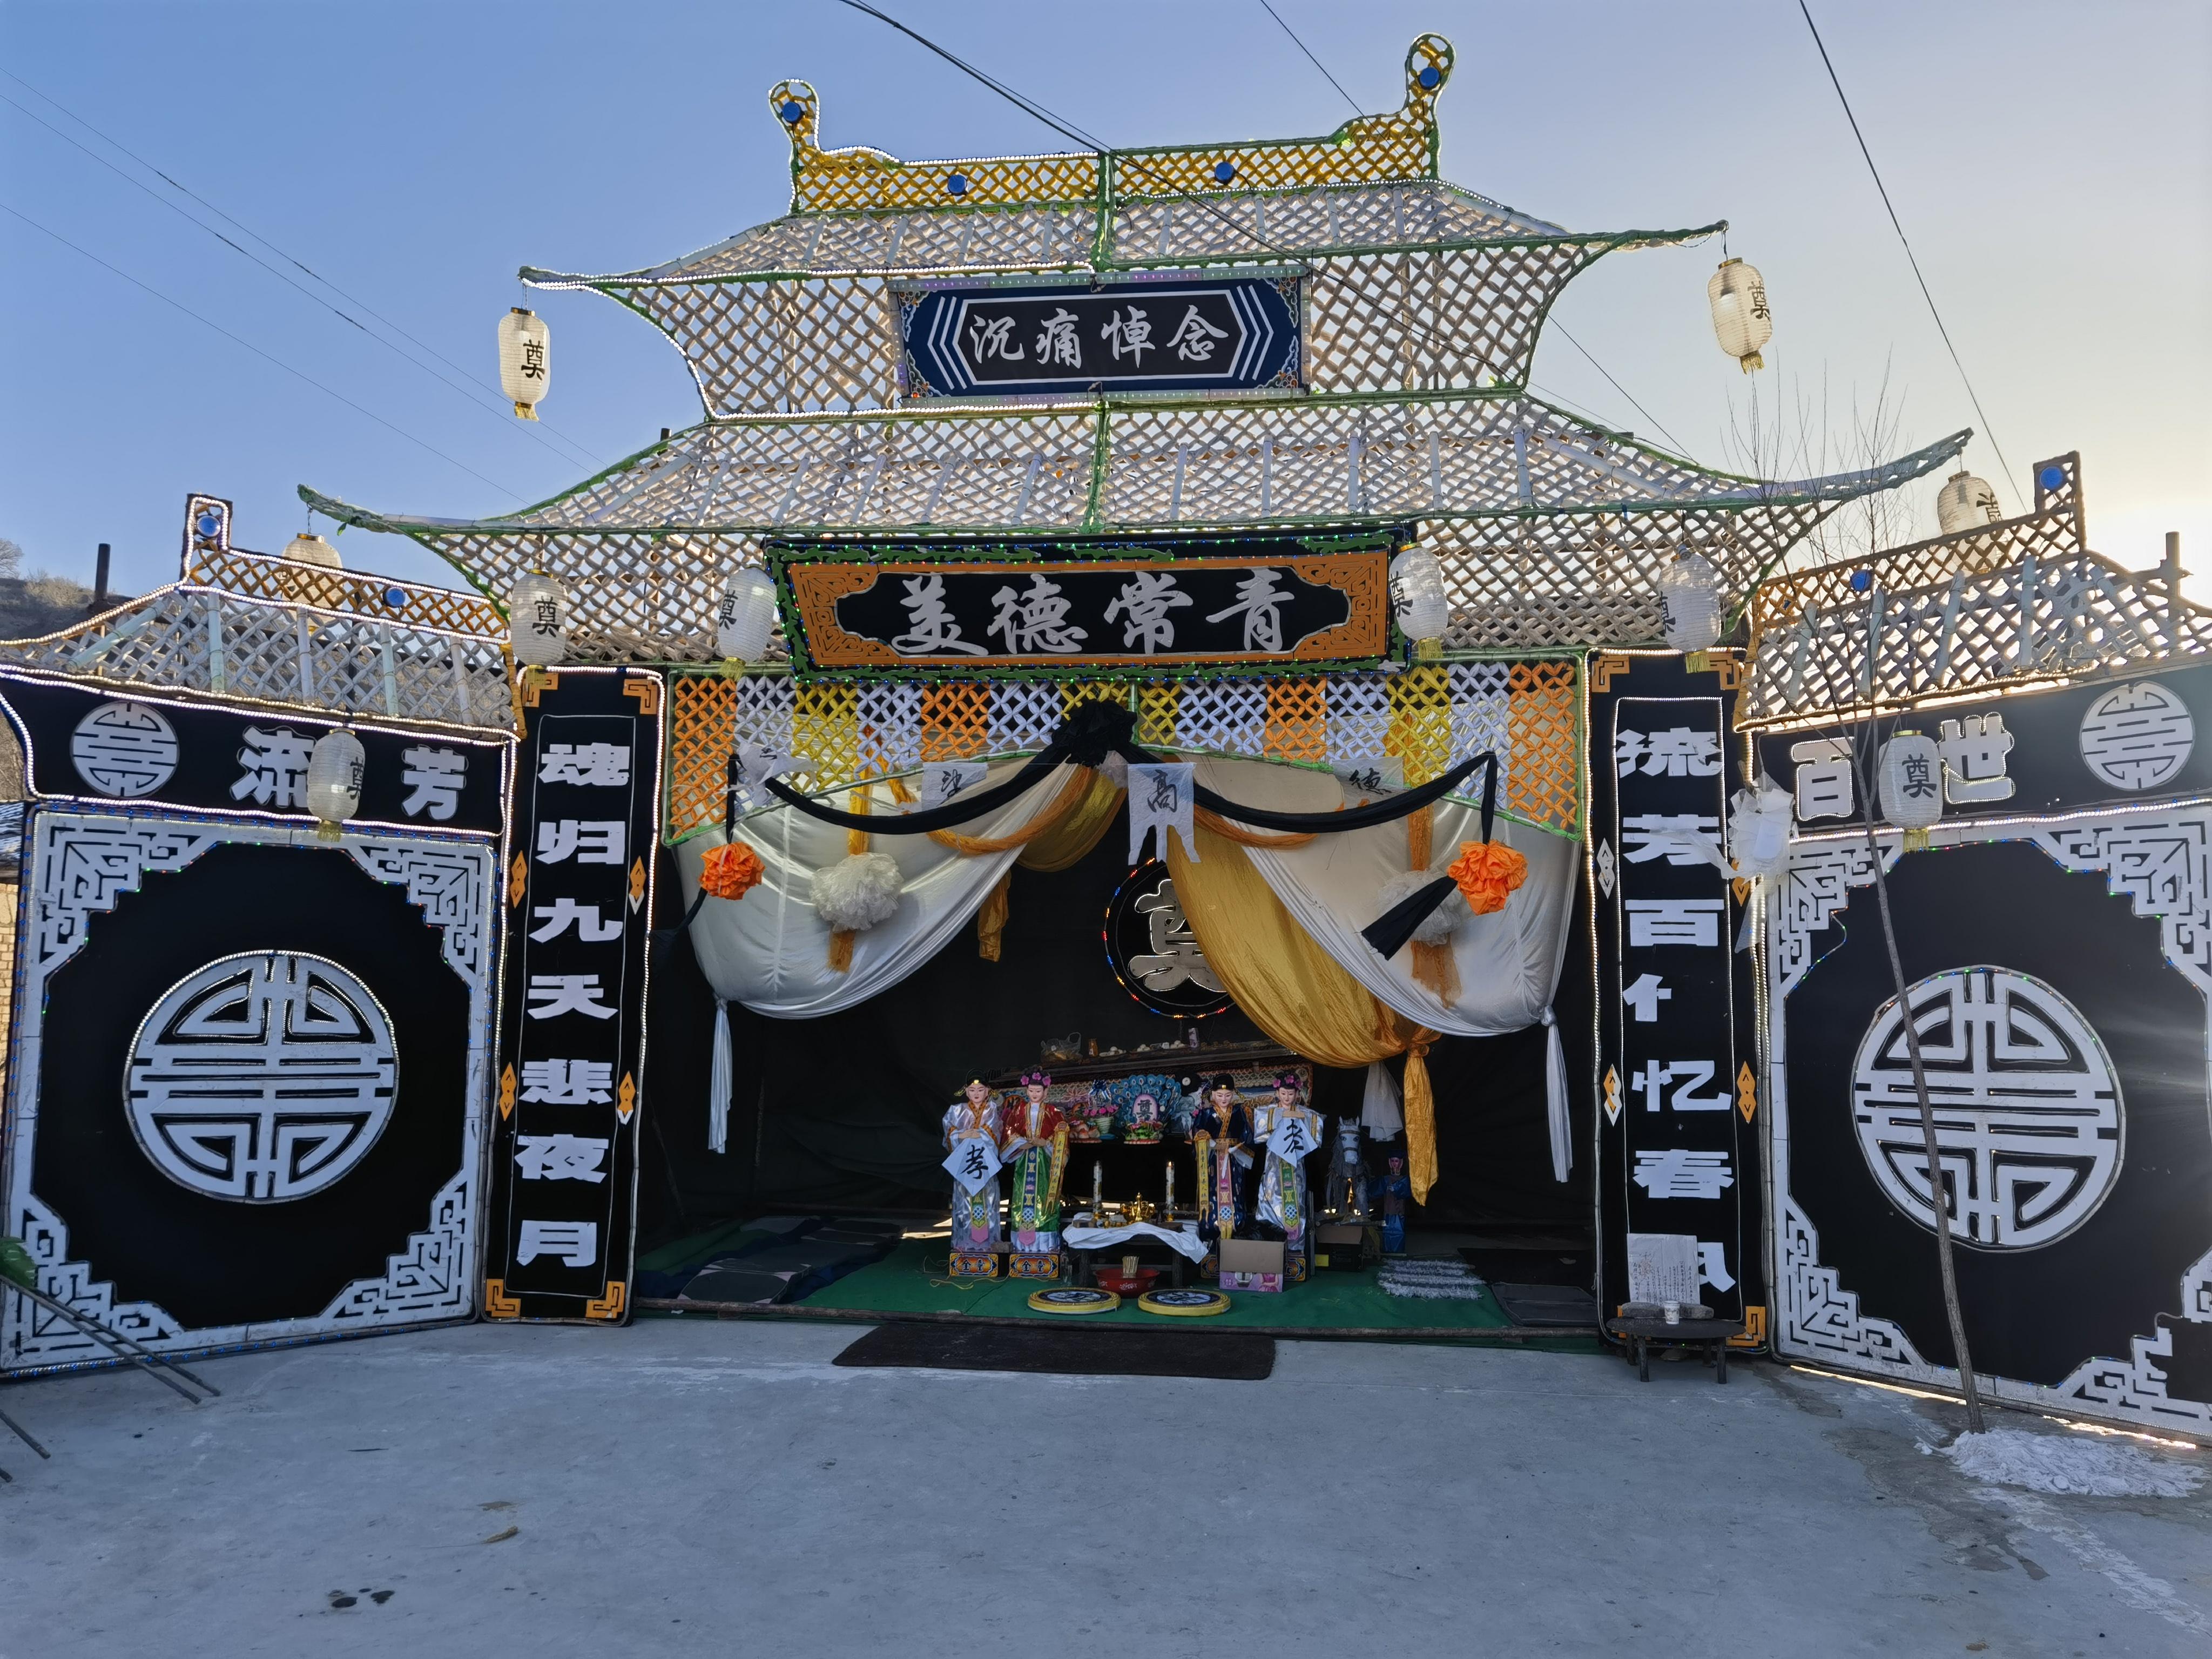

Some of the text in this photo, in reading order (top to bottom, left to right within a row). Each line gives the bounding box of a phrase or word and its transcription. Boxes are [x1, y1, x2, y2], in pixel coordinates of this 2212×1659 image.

[970, 305, 1229, 368] 沉痛悼念
[521, 339, 545, 381] 奠
[532, 595, 562, 638] 奠
[718, 589, 738, 630] 奠
[891, 565, 1294, 656] 美德常青
[1792, 711, 2015, 822] 百世
[1901, 752, 1937, 799] 奠
[1147, 768, 1178, 813] 高
[514, 743, 630, 1268] 魂归九天悲夜月
[960, 1144, 989, 1179] 孝
